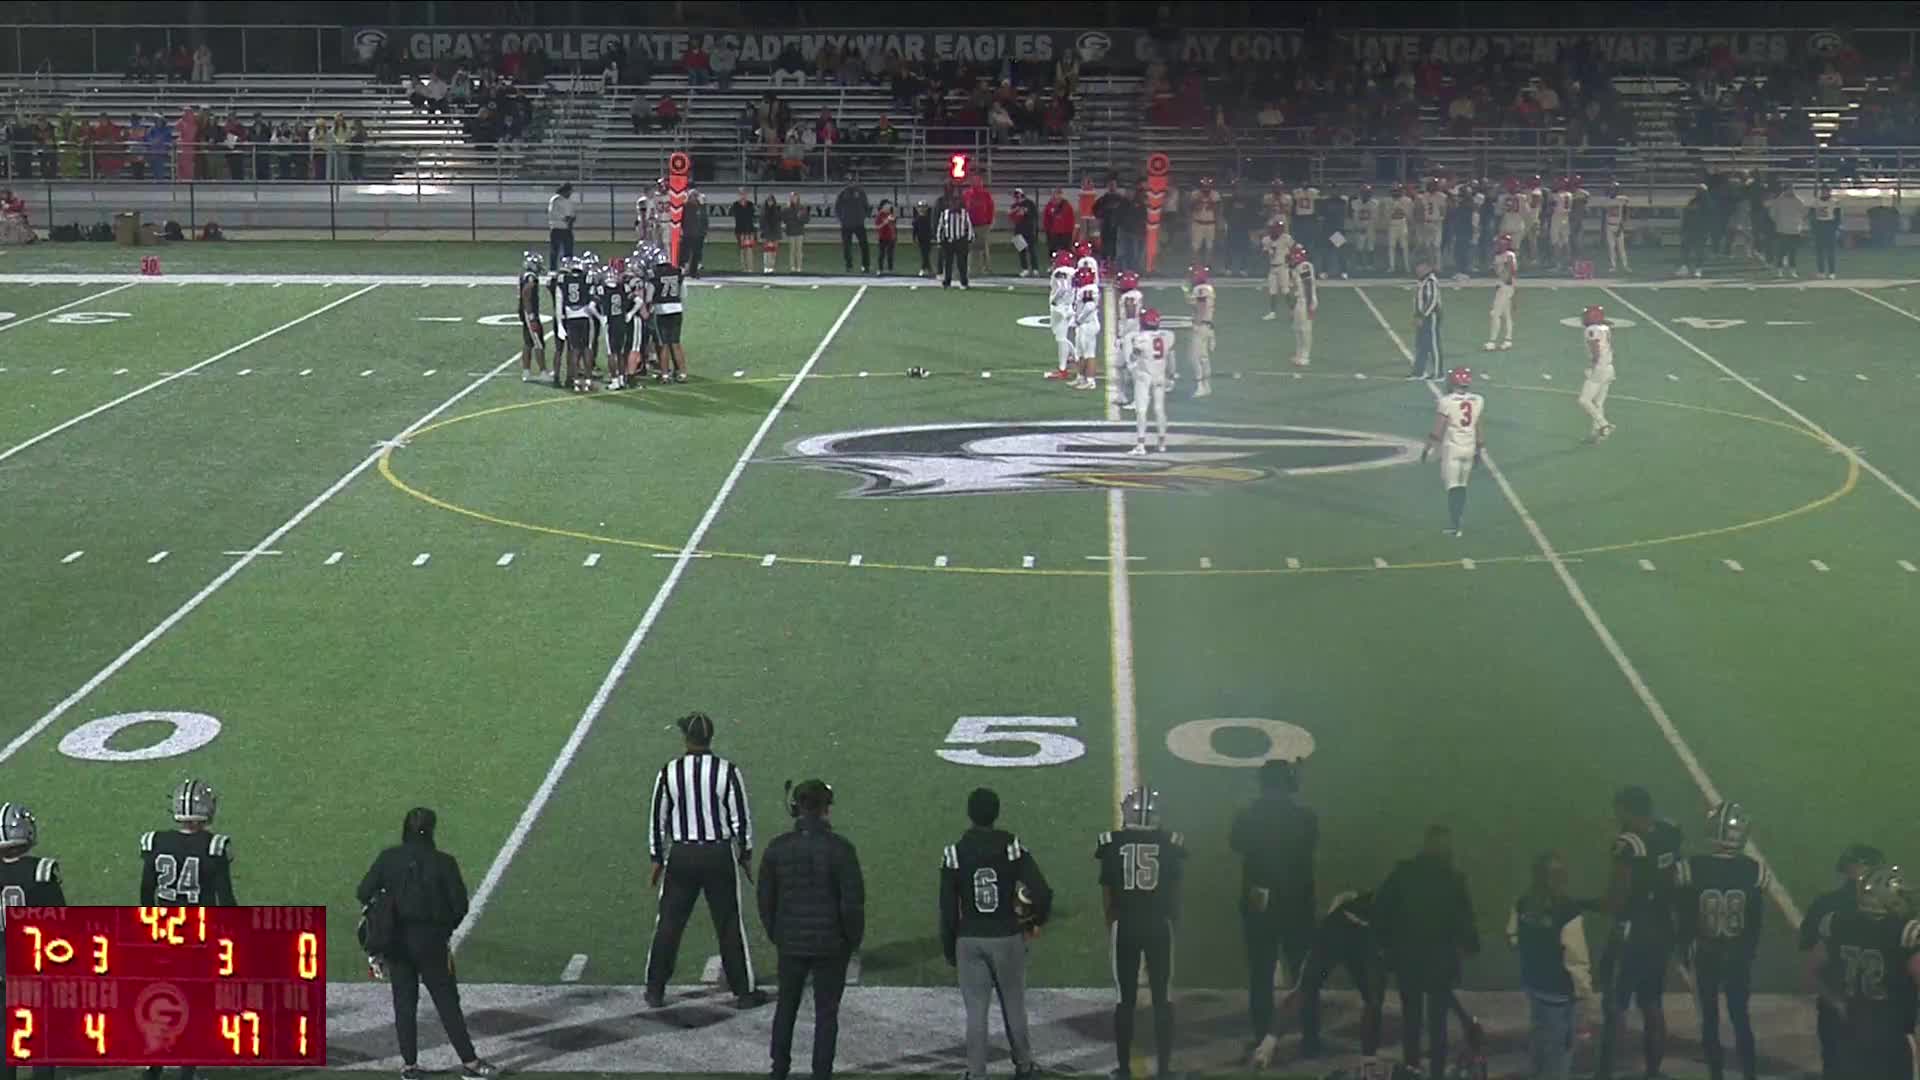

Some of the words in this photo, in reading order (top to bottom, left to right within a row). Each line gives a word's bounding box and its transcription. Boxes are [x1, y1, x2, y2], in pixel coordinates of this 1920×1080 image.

[935, 34, 1053, 61] EAGLES
[1152, 336, 1164, 360] 9
[1460, 401, 1472, 427] 3
[155, 854, 200, 903] 24
[1119, 843, 1159, 890] 15
[973, 867, 999, 912] 6
